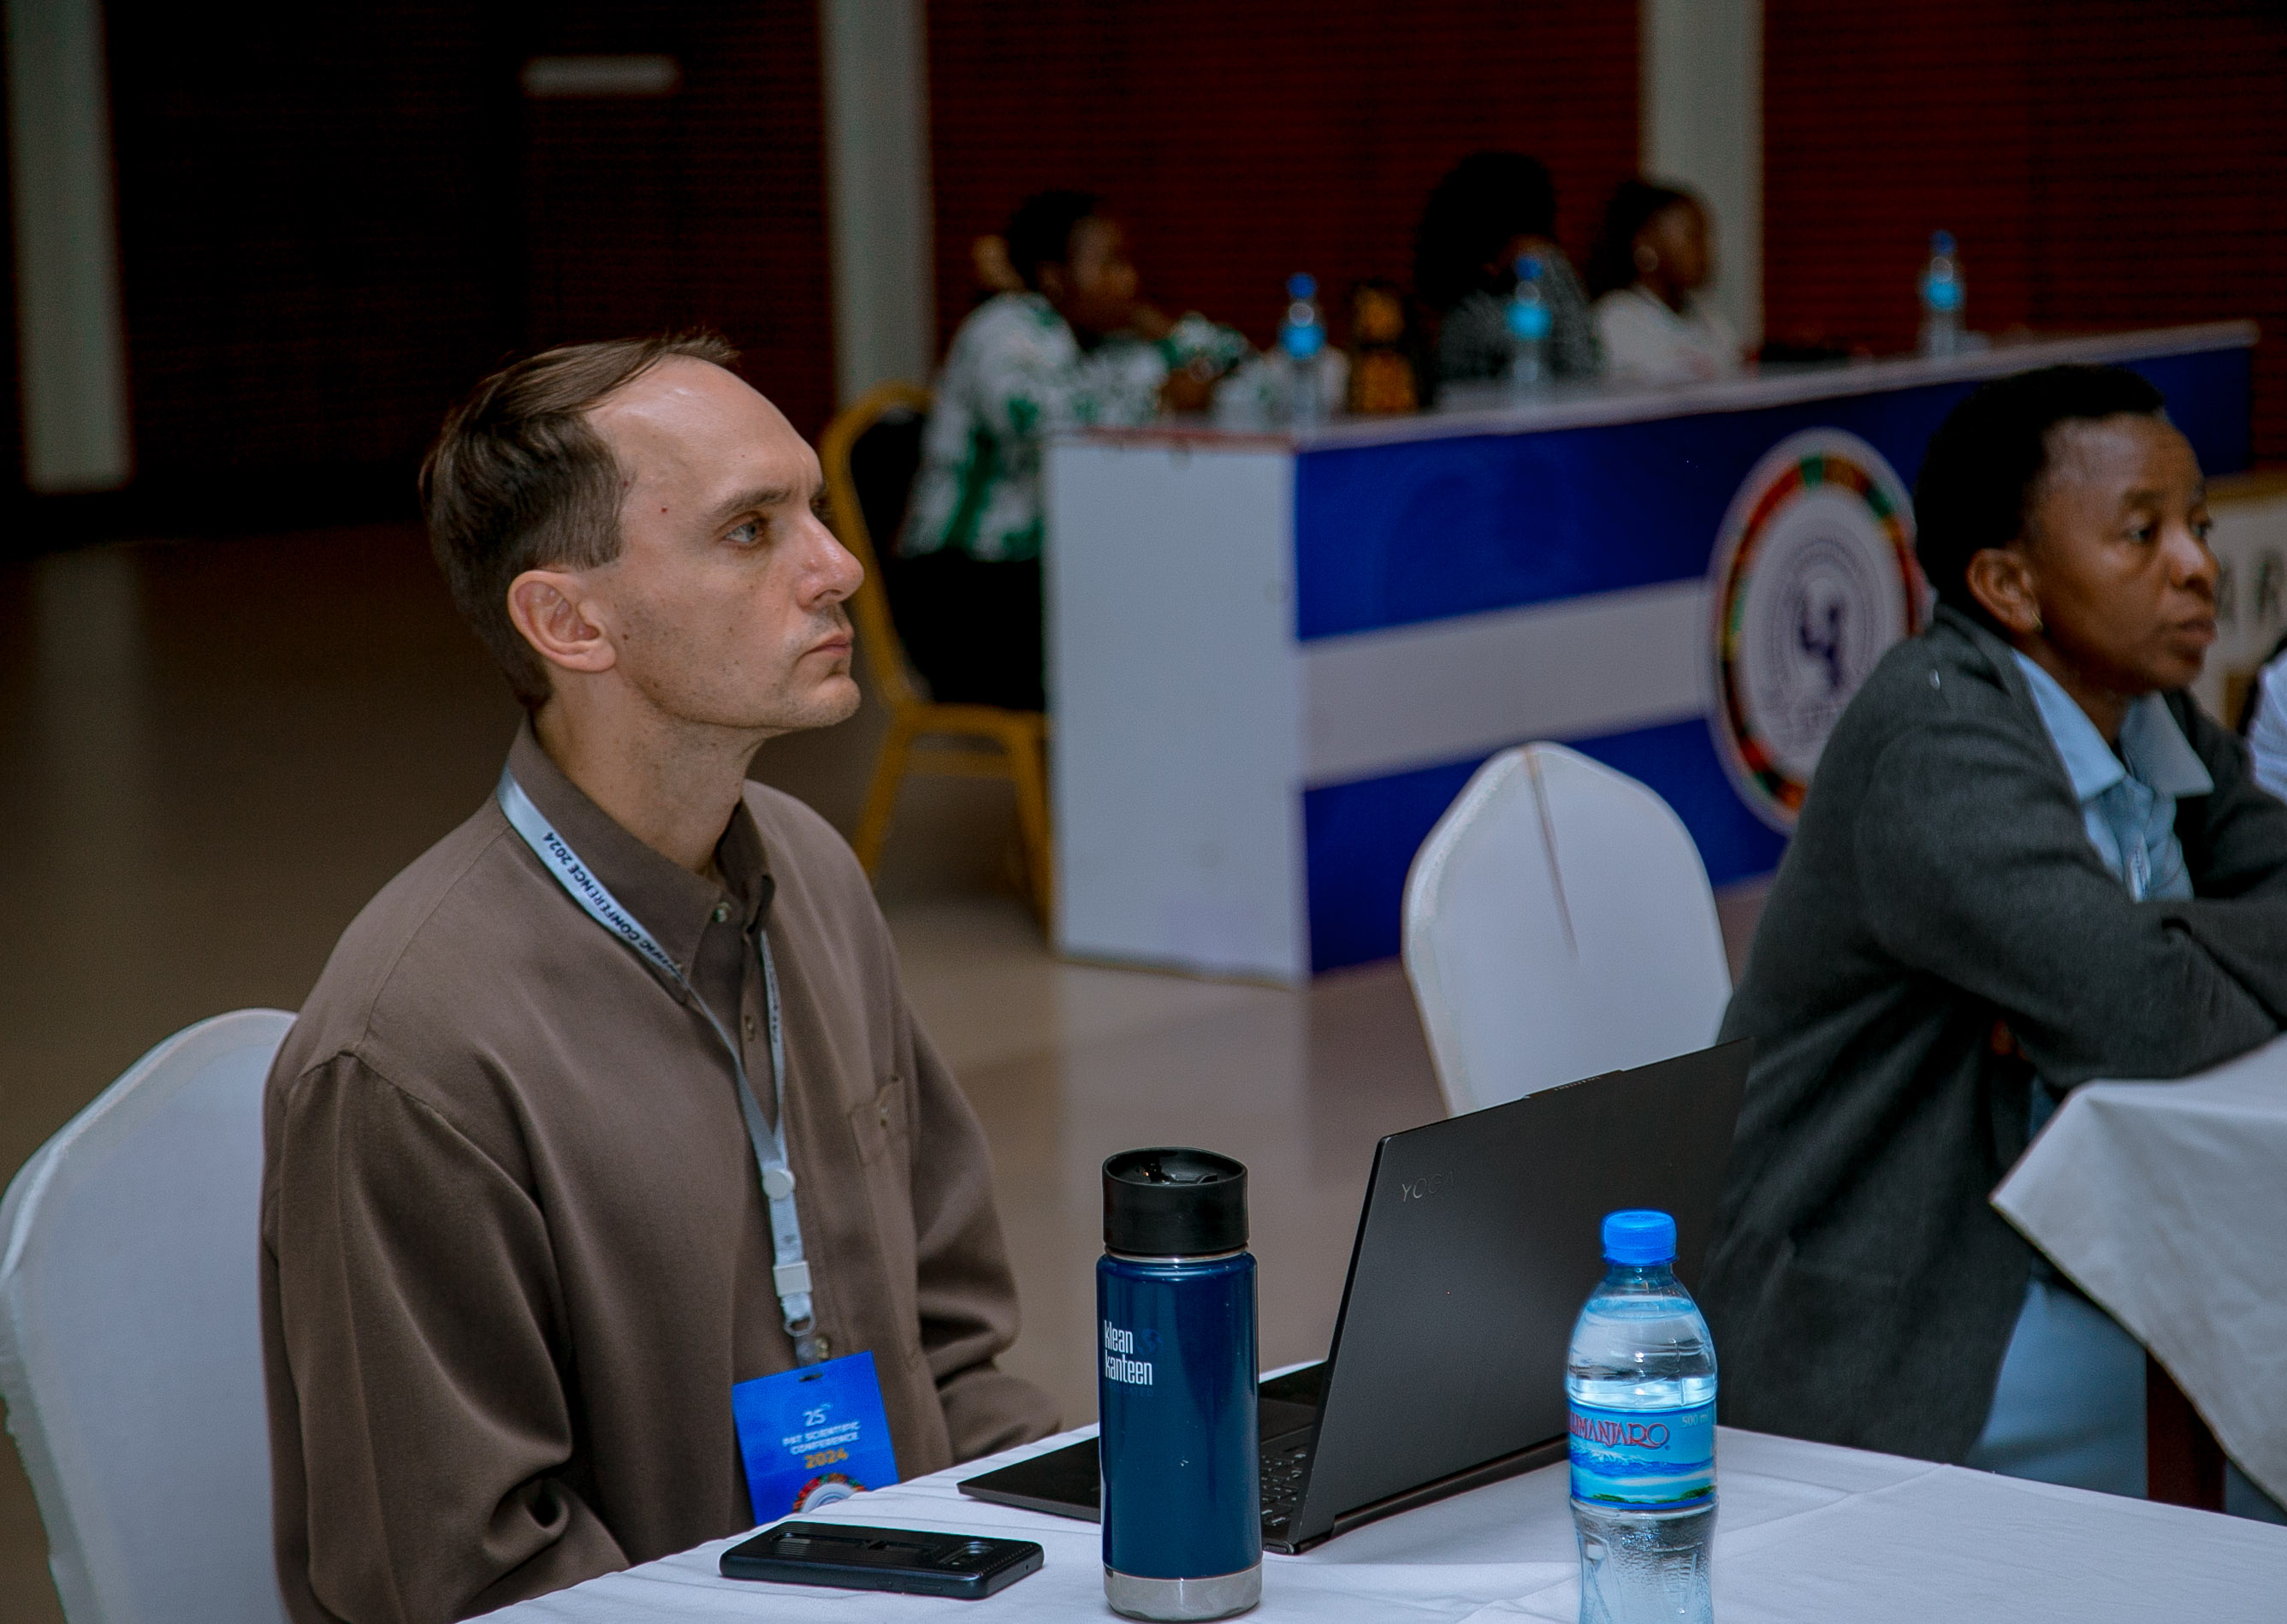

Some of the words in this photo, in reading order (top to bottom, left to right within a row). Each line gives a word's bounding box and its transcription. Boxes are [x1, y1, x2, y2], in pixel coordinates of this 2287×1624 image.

[542, 831, 572, 863] 2024
[568, 863, 643, 942] CONFERENCE
[1104, 1319, 1134, 1354] klean
[1105, 1349, 1153, 1386] kanteen
[805, 1421, 860, 1441] SCIENTIFIC
[1681, 1414, 1698, 1427] 500
[791, 1431, 859, 1455] CONFERENCE
[804, 1447, 848, 1469] 2024
